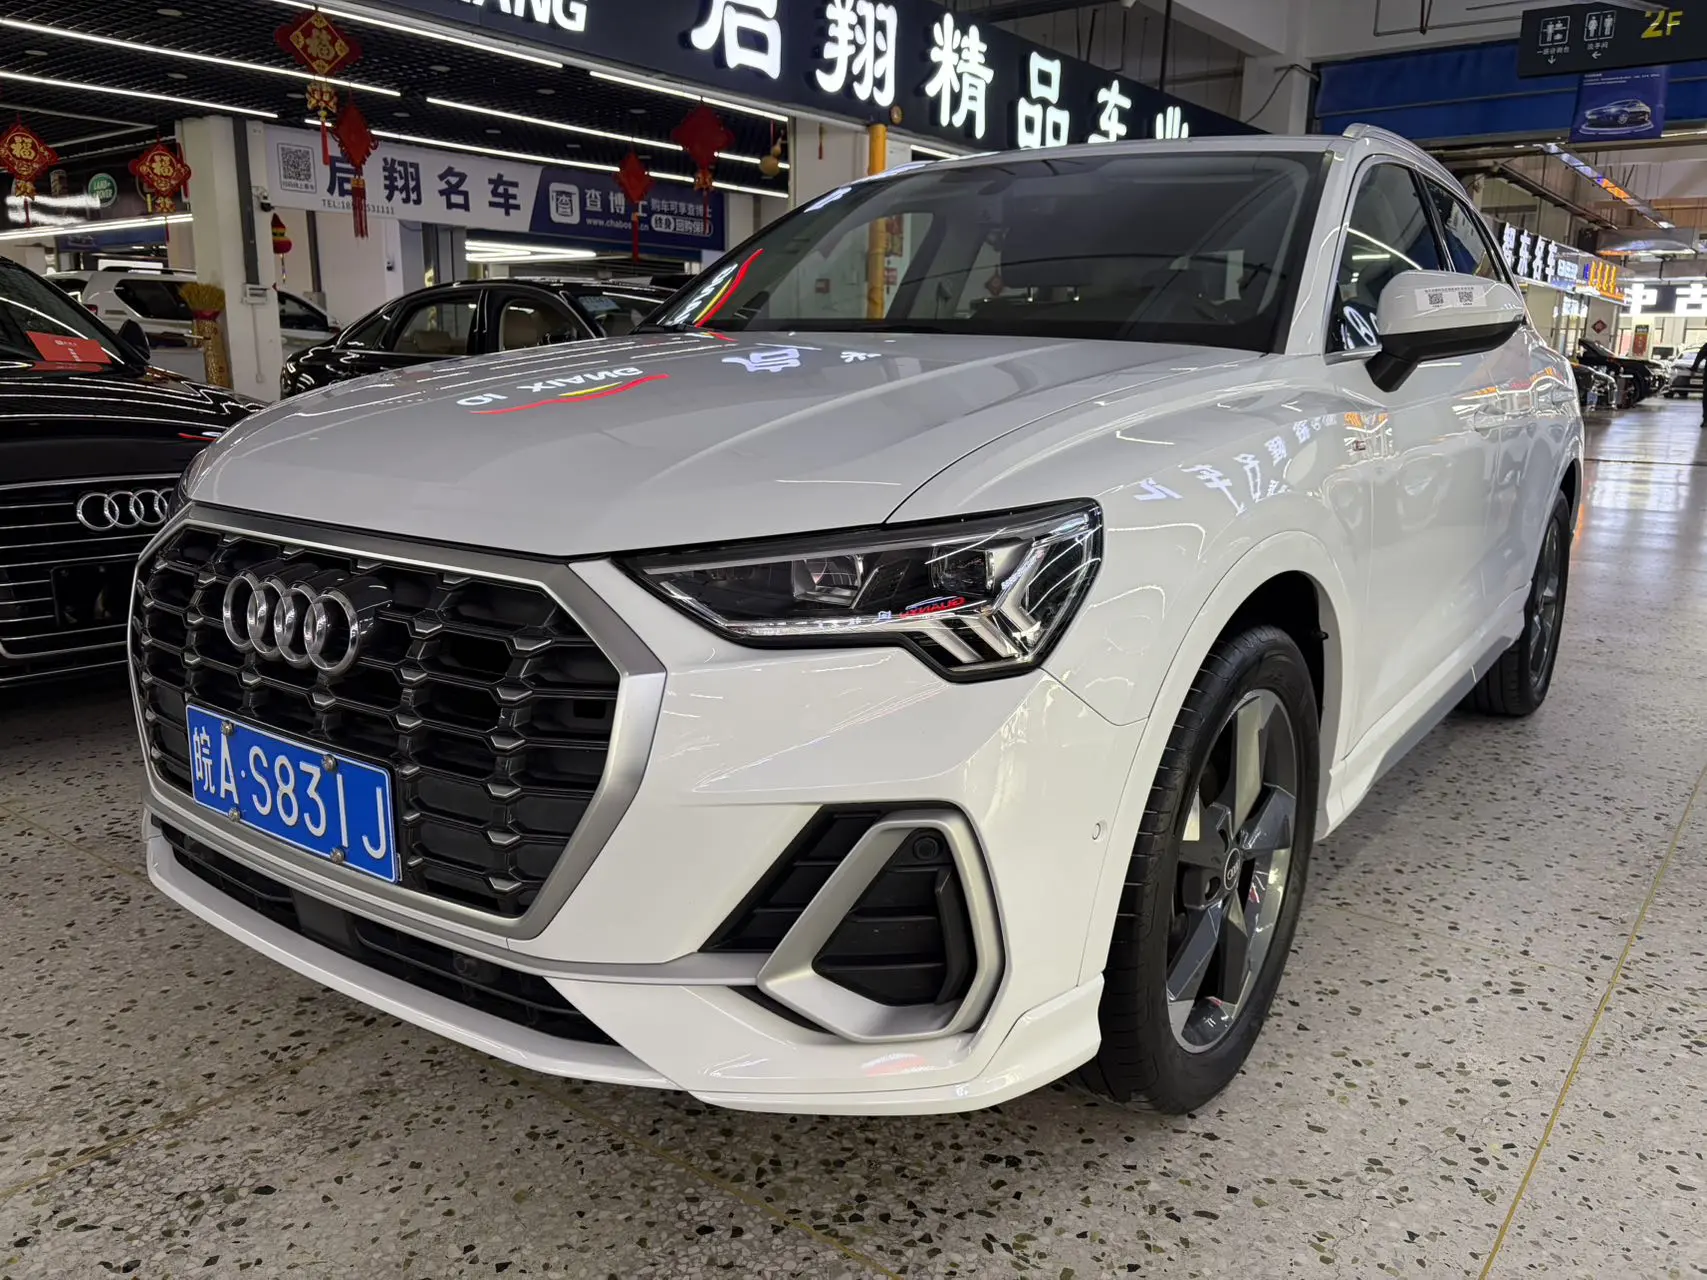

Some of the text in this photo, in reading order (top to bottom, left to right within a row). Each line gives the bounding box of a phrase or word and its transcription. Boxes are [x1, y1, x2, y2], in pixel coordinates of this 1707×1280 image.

[1641, 10, 1684, 39] 2F
[11, 135, 36, 160] 福
[326, 151, 521, 217] 启翔名车
